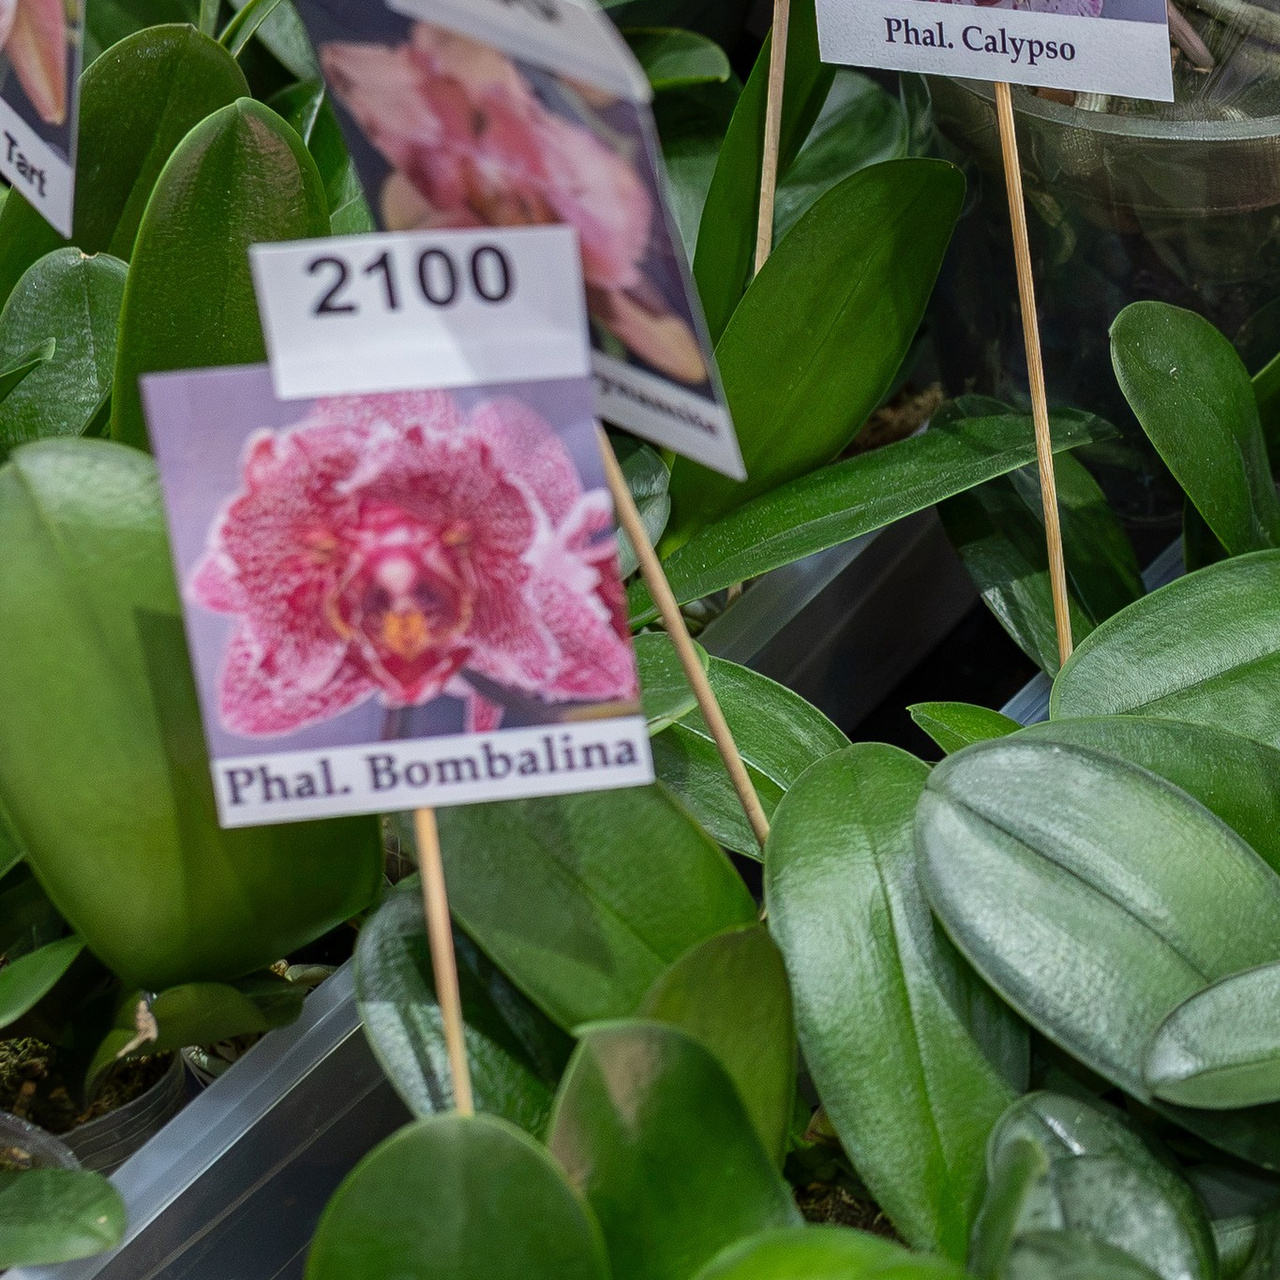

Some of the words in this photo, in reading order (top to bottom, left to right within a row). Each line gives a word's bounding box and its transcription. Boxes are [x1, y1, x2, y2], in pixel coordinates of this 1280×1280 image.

[884, 17, 954, 49] Phal.
[961, 25, 1075, 66] Calypso
[4, 130, 47, 198] Tart
[307, 245, 513, 316] 2100
[225, 763, 350, 807] Phal.
[366, 733, 639, 791] Bombalina
